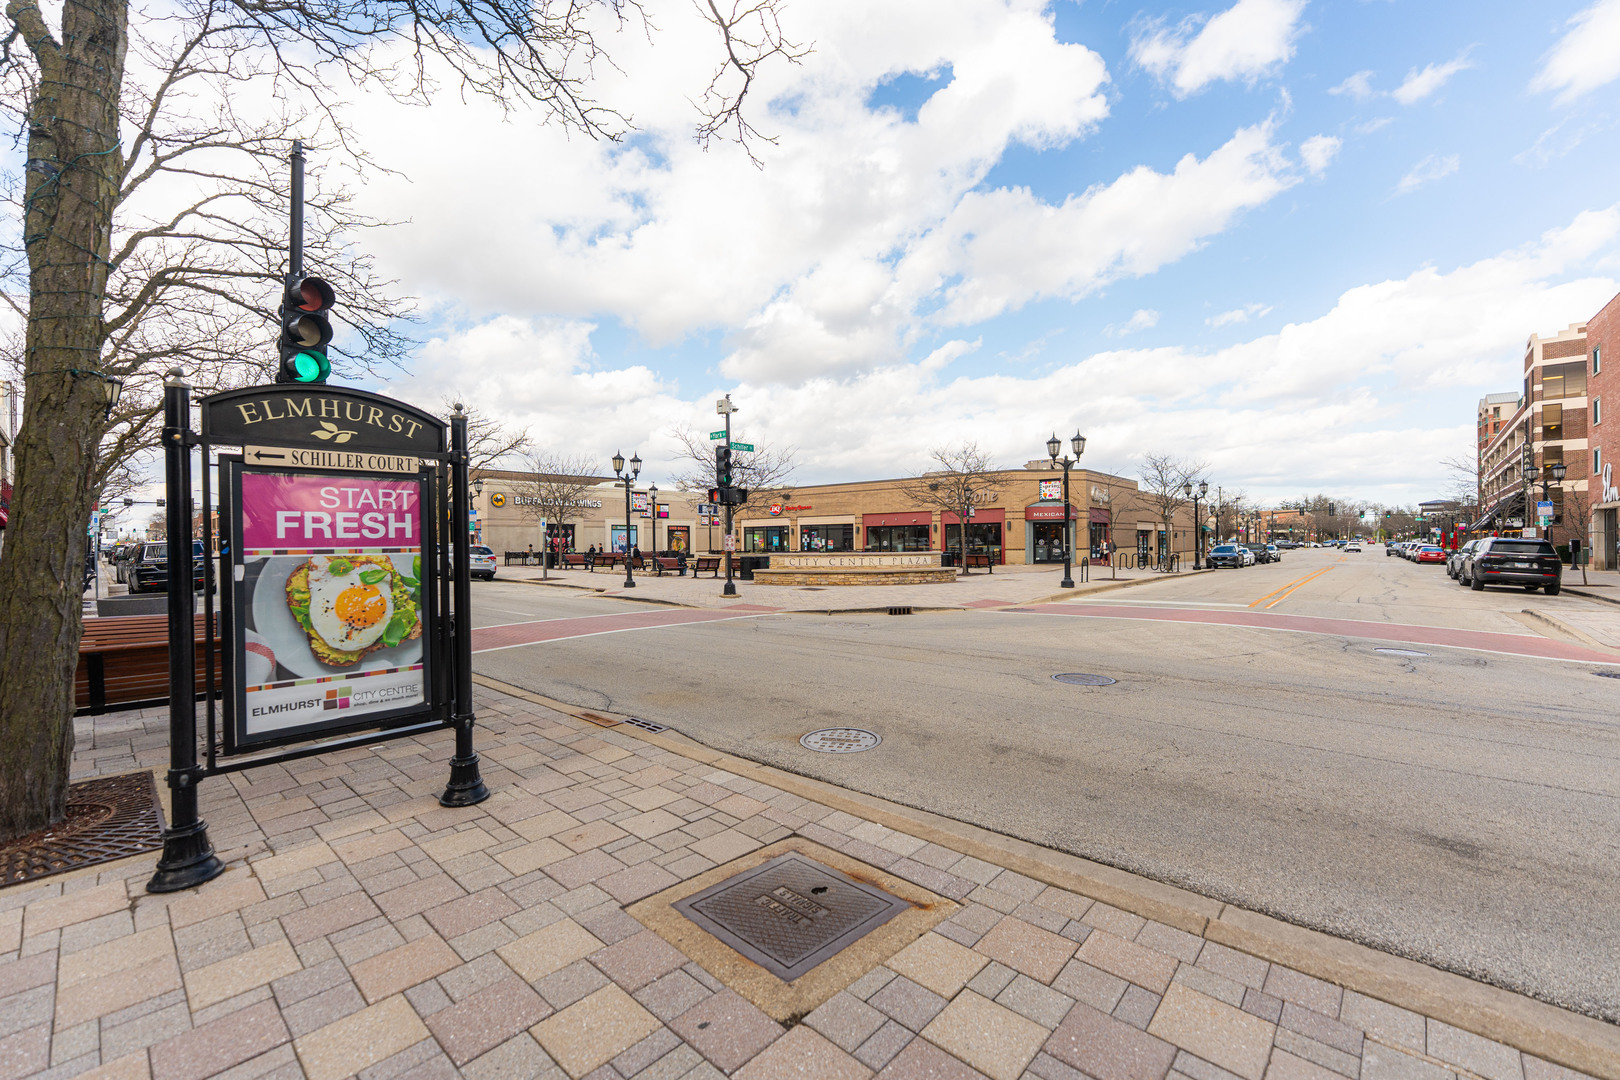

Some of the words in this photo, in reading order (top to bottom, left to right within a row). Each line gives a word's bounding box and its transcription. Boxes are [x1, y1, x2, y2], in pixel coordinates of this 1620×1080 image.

[235, 397, 422, 439] ELMHURST
[291, 450, 363, 467] SCHILLER
[368, 455, 413, 471] COURT
[319, 486, 414, 510] START
[577, 499, 603, 508] WINGS
[276, 510, 413, 539] FRESH
[789, 558, 820, 566] CITY
[828, 557, 883, 566] CENTRE
[892, 557, 928, 565] PLAZA
[353, 690, 377, 701] CITY
[378, 683, 419, 697] CENTRE
[252, 698, 322, 717] ELMHURST
[760, 898, 804, 924] TRAFFIC
[779, 889, 822, 914] SIGNALS
